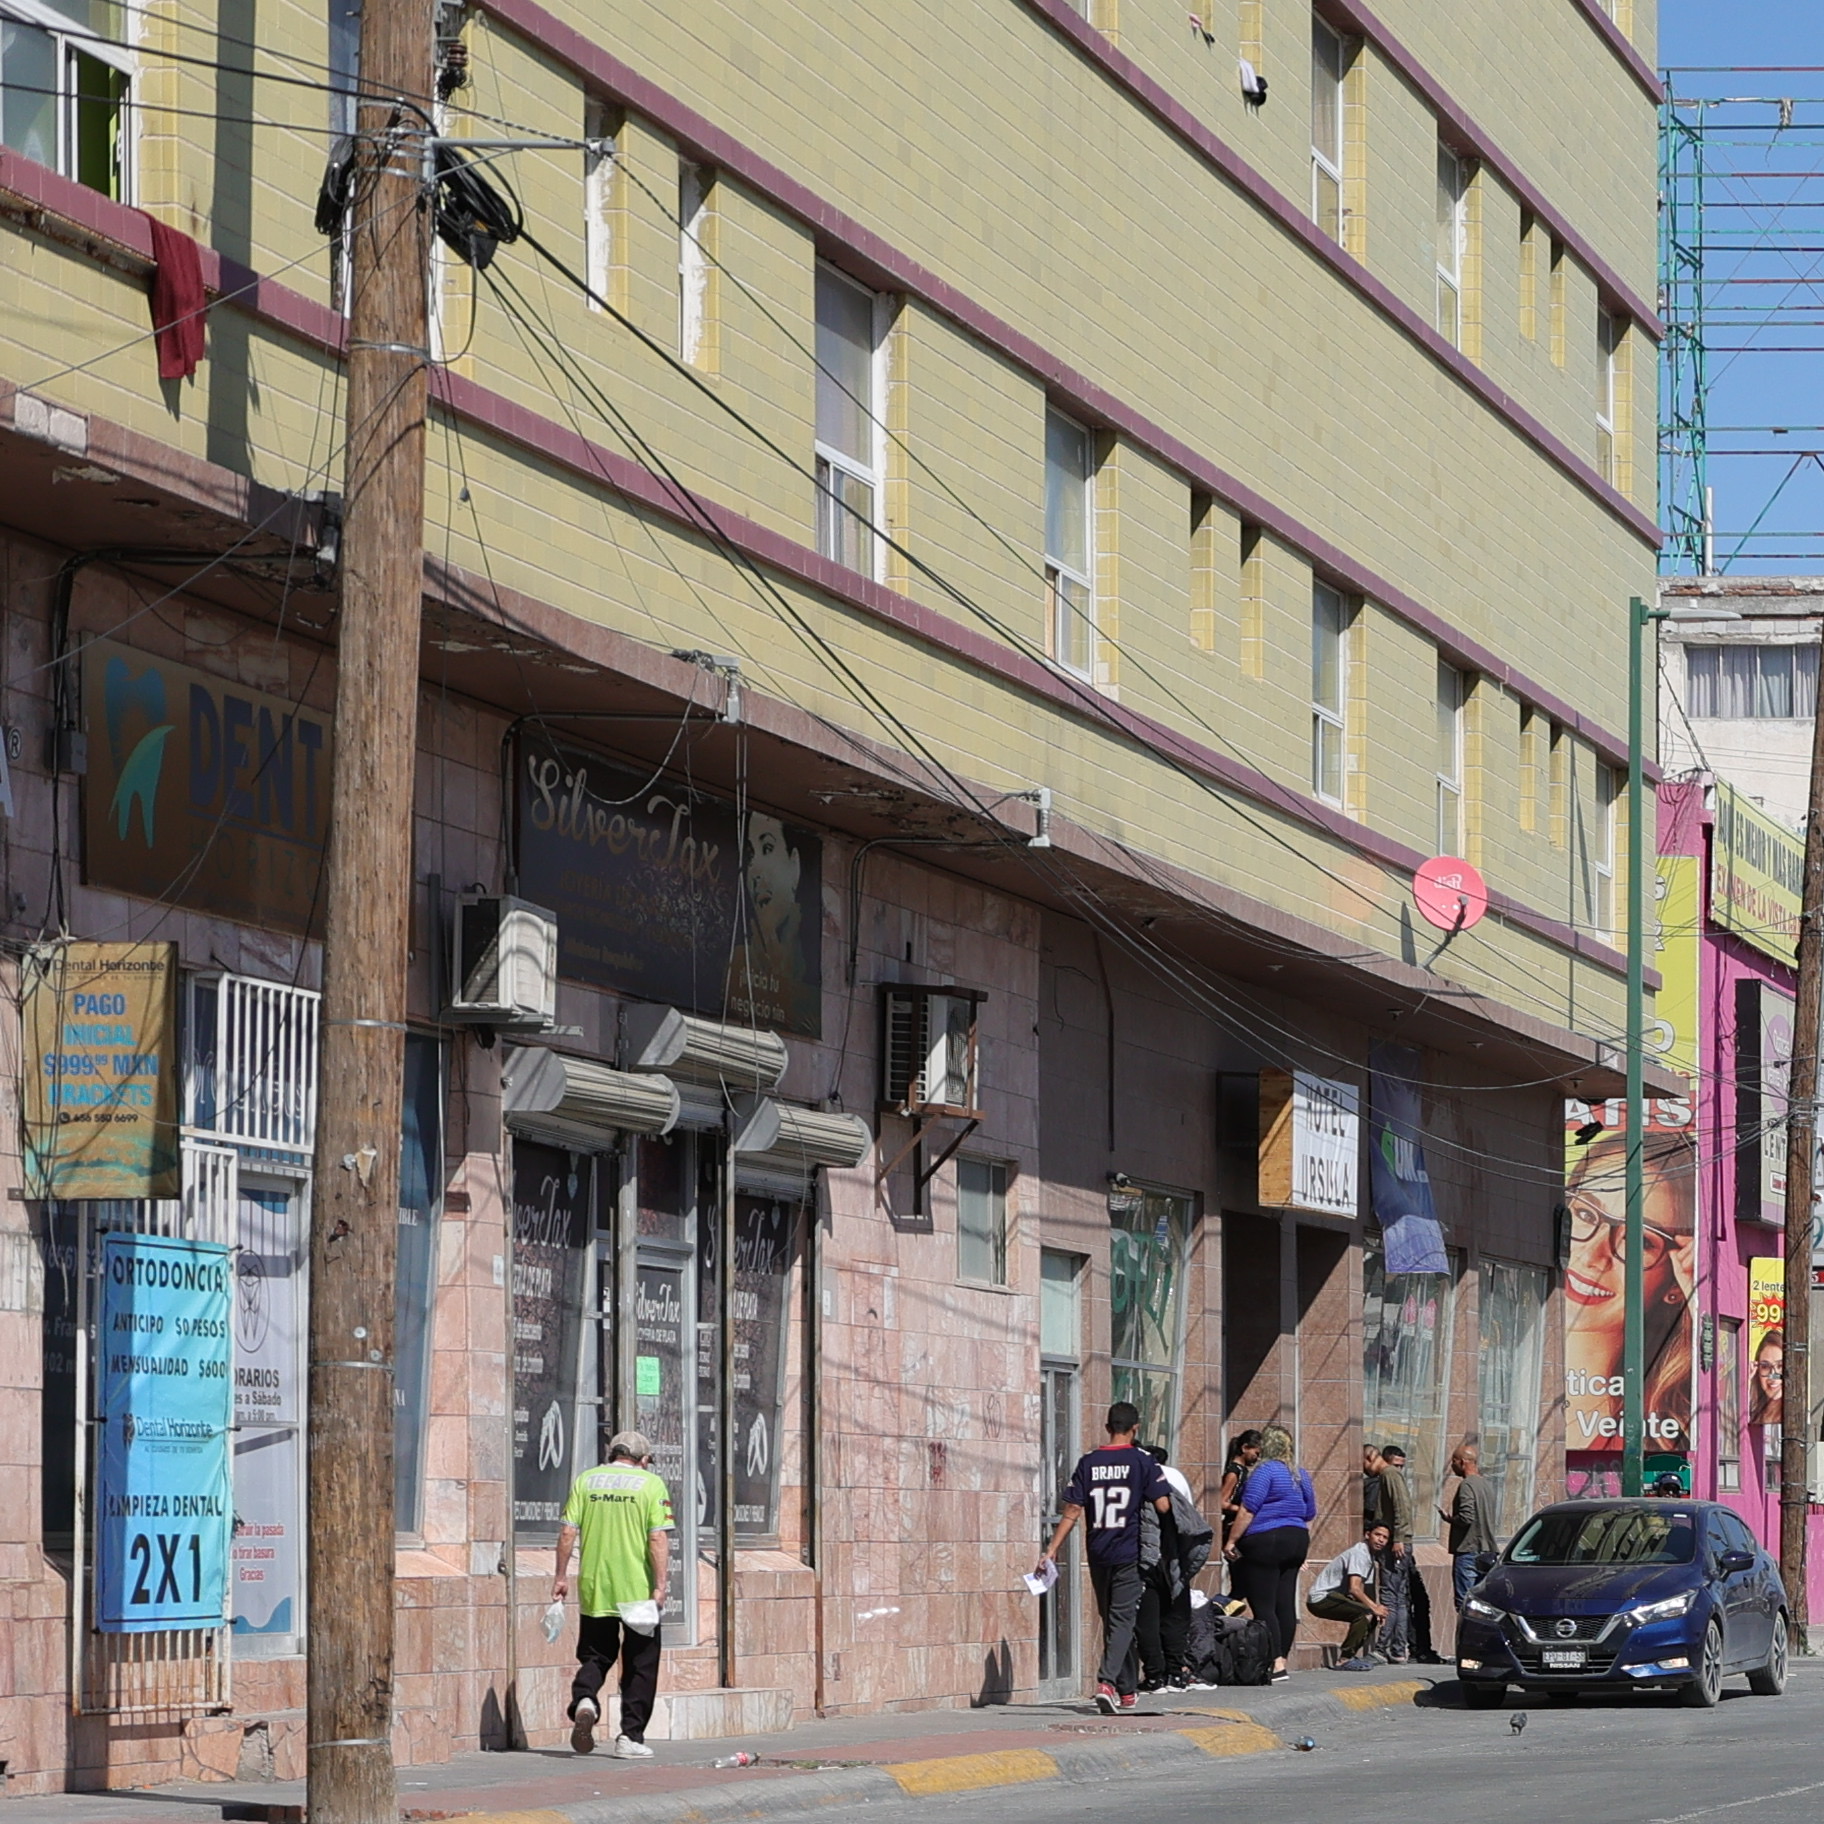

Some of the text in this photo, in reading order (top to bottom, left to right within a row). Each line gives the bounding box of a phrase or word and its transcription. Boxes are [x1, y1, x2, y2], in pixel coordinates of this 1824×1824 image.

[54, 959, 96, 971] Dental
[73, 993, 126, 1016] PAGO
[63, 1024, 138, 1046] INICIAL
[112, 1055, 158, 1076] MXN
[47, 1084, 152, 1106] BRACKETS
[1306, 1083, 1345, 1137] HOTEL
[1302, 1154, 1350, 1209] URSULA
[112, 1256, 224, 1294] ORTODONCIA
[1753, 1280, 1760, 1291] 2
[1756, 1304, 1781, 1323] 99
[113, 1313, 225, 1338] ANTICIPO $0 PESOS
[111, 1356, 226, 1378] MENSUALIDAD $600
[252, 1392, 281, 1407] Sábado
[136, 1416, 213, 1438] Dental Horizonte
[587, 1473, 646, 1490] TECATE
[1091, 1465, 1130, 1481] BRADY
[109, 1495, 222, 1517] LIMPIEZA DENTAL
[1089, 1486, 1131, 1529] 12
[130, 1533, 200, 1605] 2X1
[240, 1567, 264, 1581] Gracias
